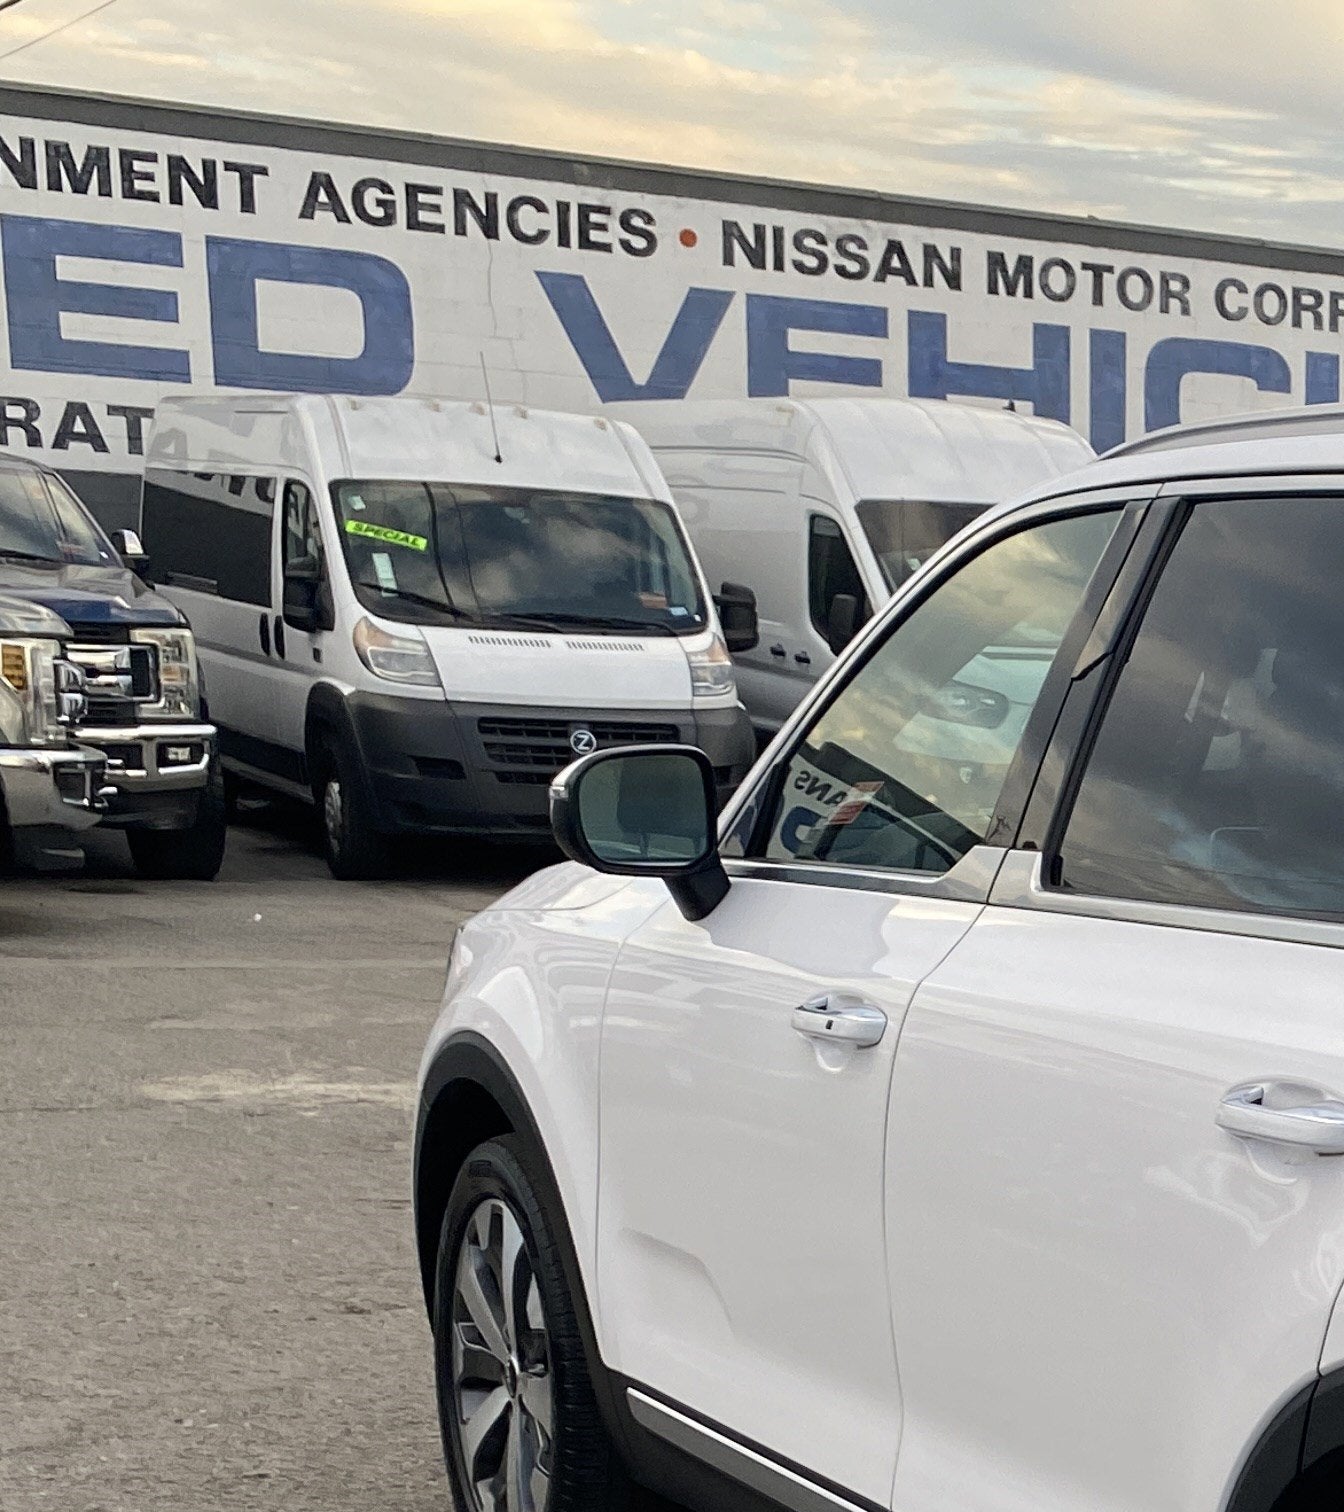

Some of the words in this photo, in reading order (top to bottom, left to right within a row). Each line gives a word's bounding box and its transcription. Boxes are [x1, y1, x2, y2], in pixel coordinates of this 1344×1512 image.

[0, 213, 415, 397] ED
[298, 171, 658, 258] AGENCIES
[721, 218, 963, 292] NISSAN
[986, 249, 1192, 316] MOTOR
